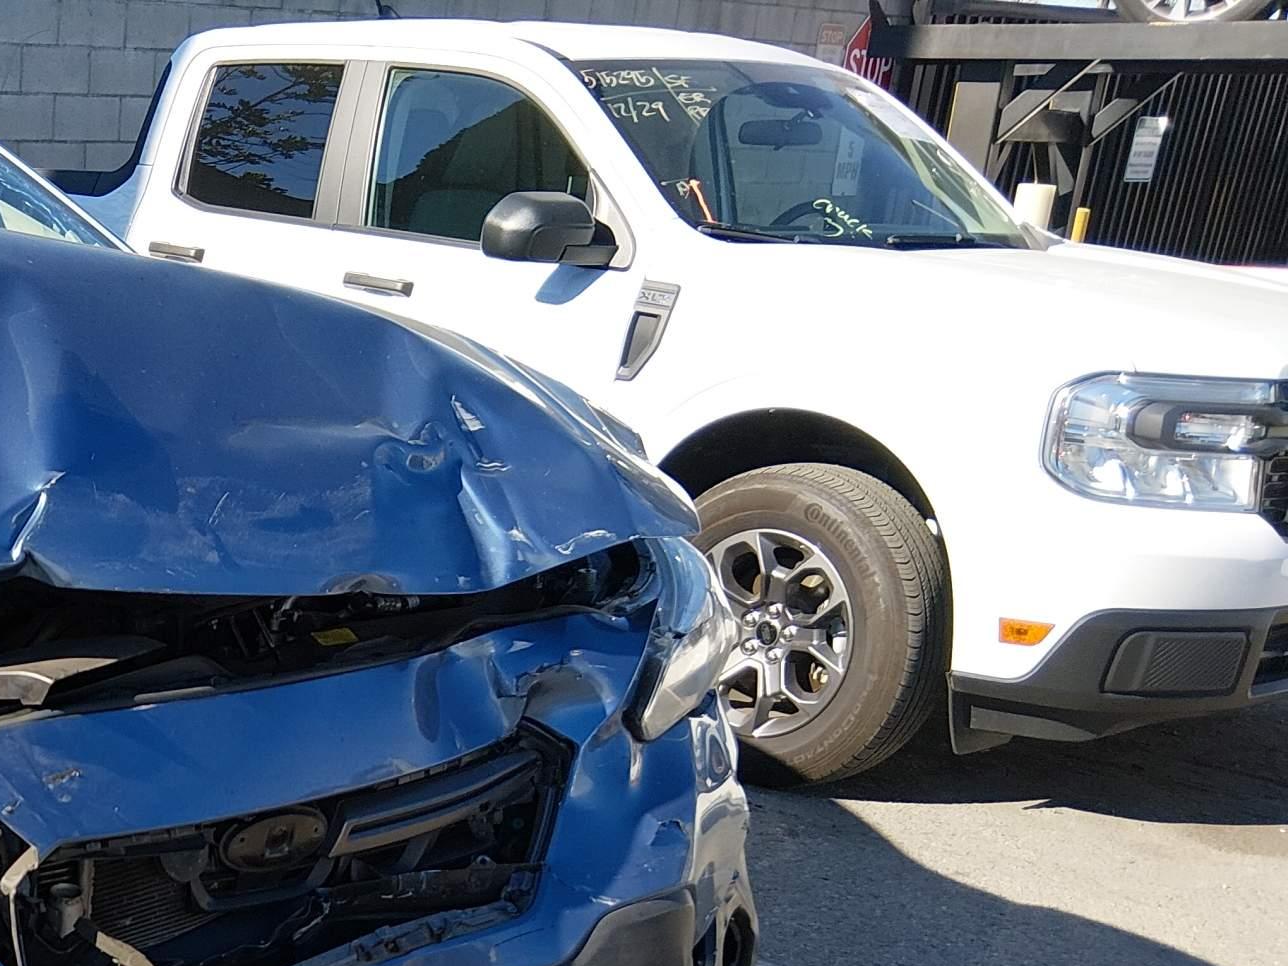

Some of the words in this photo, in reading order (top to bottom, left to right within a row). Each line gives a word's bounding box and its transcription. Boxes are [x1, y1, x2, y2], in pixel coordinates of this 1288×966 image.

[822, 30, 844, 43] STOP
[849, 48, 892, 86] STOP
[606, 97, 671, 123] 12/29
[803, 502, 877, 580] Continental
